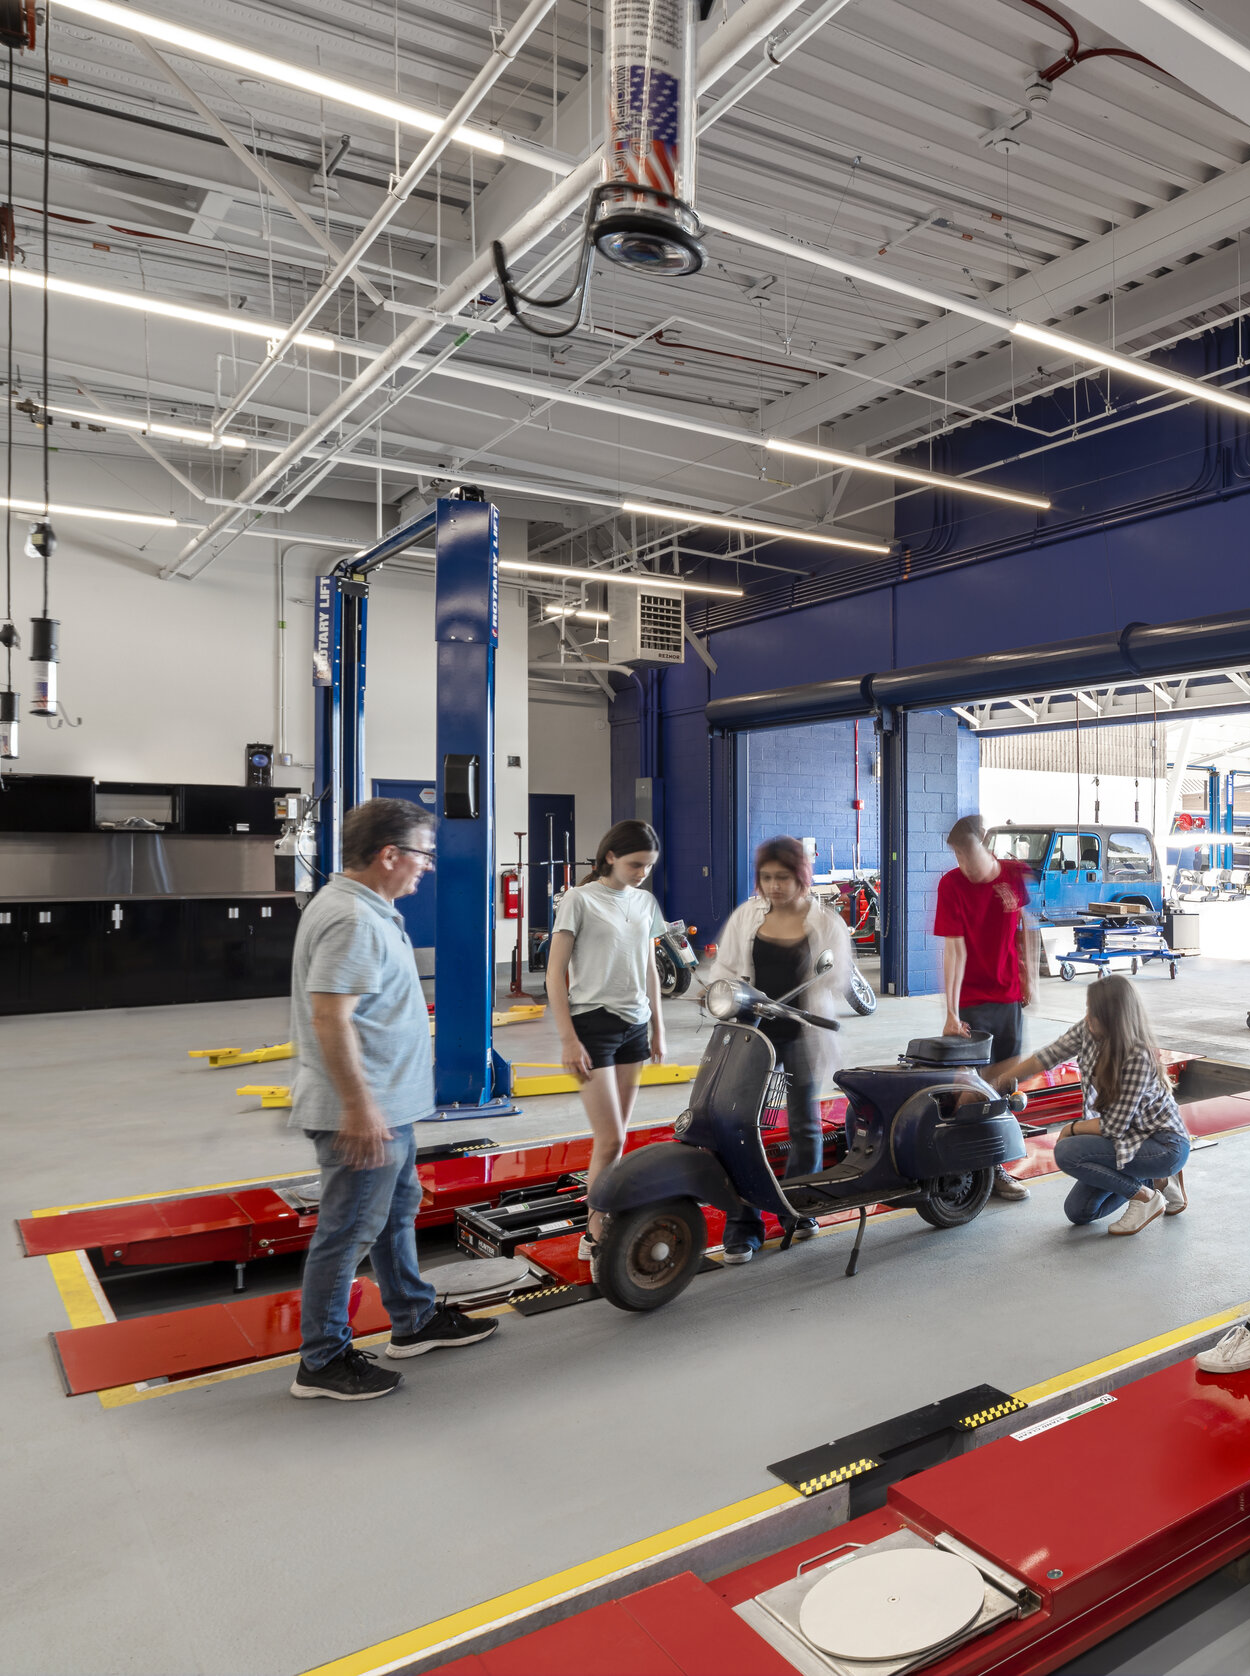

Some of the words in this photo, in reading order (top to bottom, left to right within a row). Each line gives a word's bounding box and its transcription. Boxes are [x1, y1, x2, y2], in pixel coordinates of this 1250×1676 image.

[320, 576, 331, 608] LIFT
[318, 611, 330, 669] OTARY
[478, 1240, 495, 1255] HUNTER
